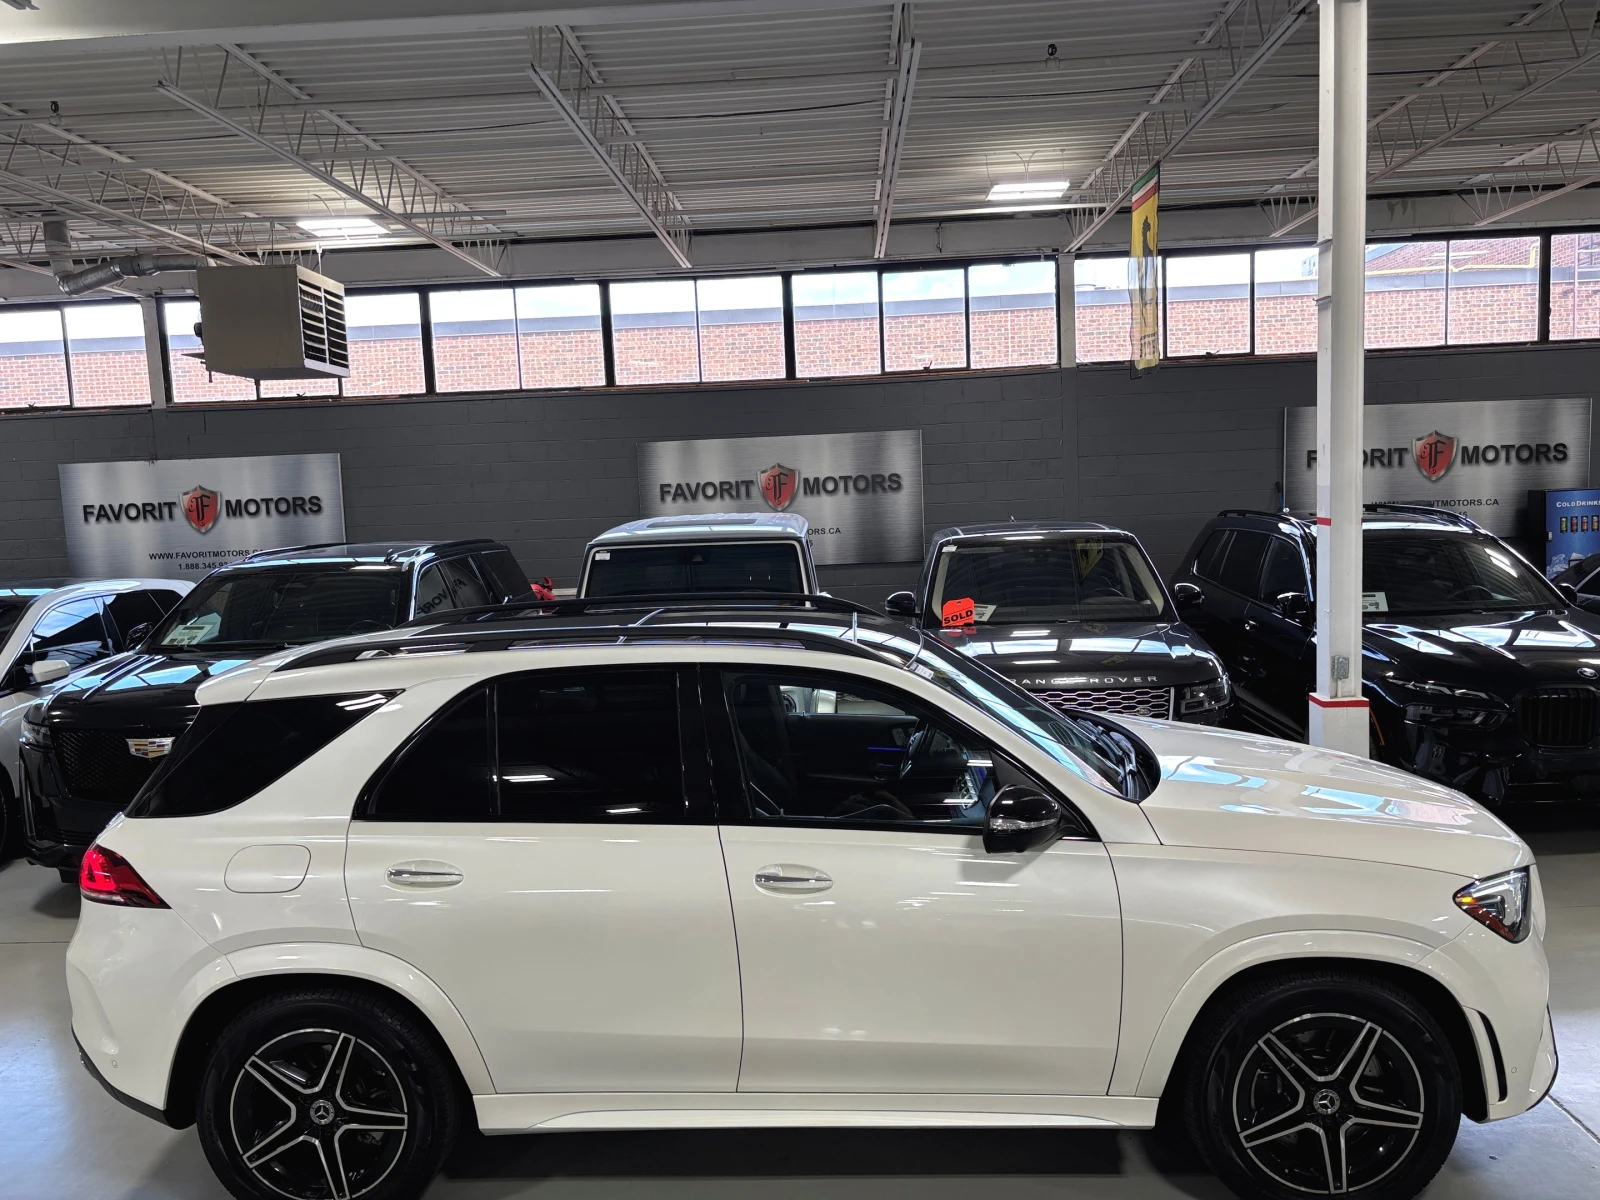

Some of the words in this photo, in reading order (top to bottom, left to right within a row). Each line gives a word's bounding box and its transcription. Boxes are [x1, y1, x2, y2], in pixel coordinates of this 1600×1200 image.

[1307, 448, 1408, 468] FRIT
[1461, 443, 1568, 465] MOTORS
[660, 480, 755, 502] FAVORIT
[803, 473, 902, 496] MOTORS
[83, 502, 177, 522] FAVORIT
[225, 496, 322, 517] MOTORS
[149, 549, 263, 560] WWW.FAVORITMOTORS
[944, 609, 973, 624] SOLD
[1090, 676, 1158, 684] ROVER
